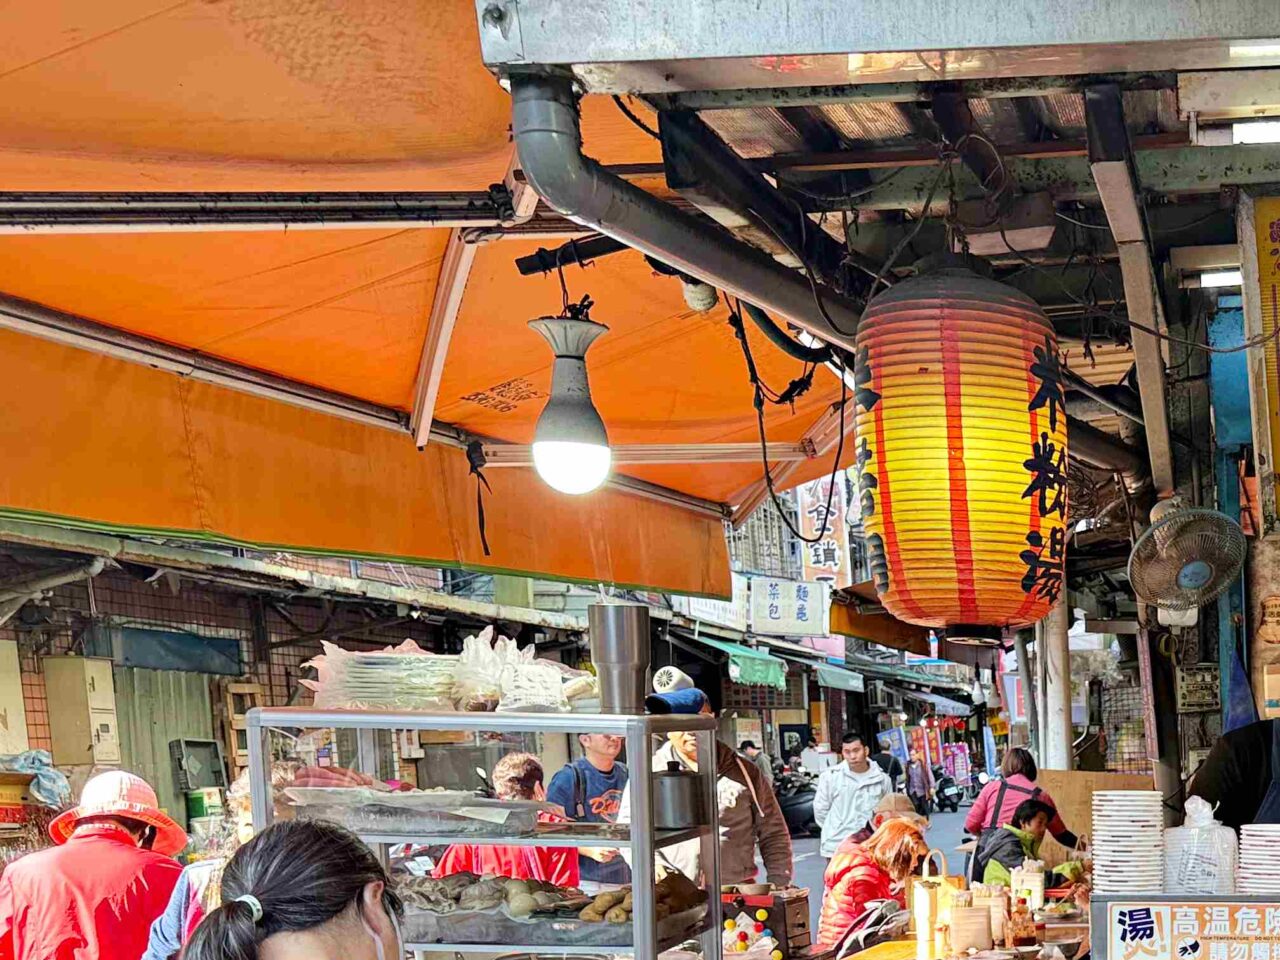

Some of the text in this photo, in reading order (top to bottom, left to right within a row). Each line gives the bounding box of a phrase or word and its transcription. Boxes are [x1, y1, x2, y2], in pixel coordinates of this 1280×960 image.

[1019, 333, 1067, 605] 米粉湯
[768, 583, 780, 620] 菜包
